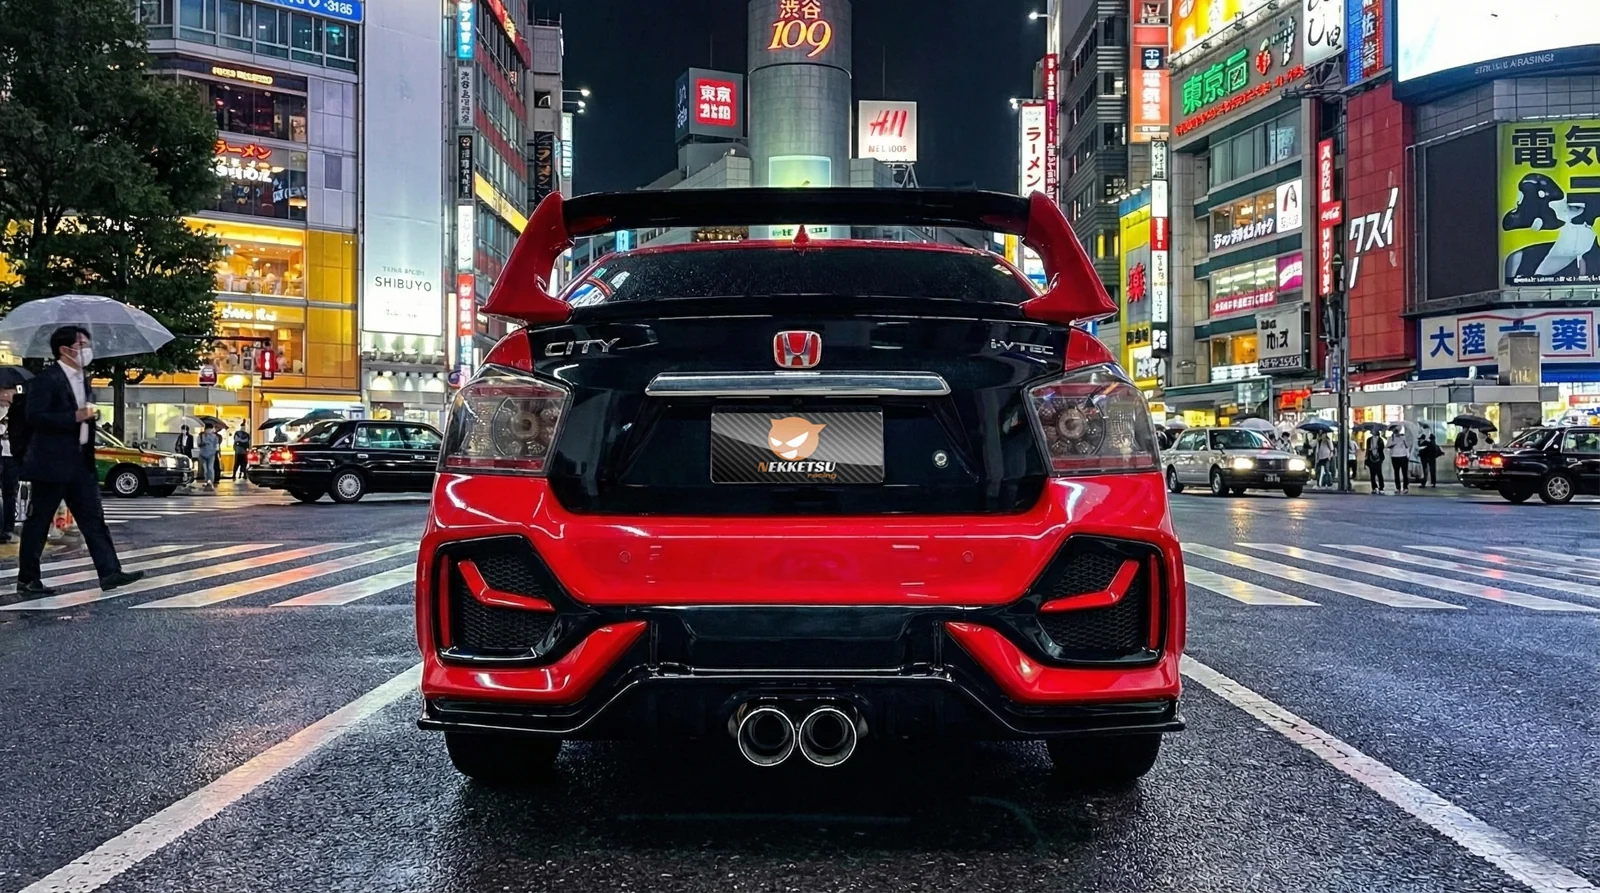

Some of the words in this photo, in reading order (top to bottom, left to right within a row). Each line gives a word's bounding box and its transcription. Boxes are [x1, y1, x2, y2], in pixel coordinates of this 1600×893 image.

[780, 0, 821, 19] 渋谷
[767, 20, 832, 57] 109
[214, 139, 272, 160] ラーメン
[1026, 126, 1042, 188] ラーメン
[375, 276, 432, 292] SHIBUYO
[544, 337, 621, 357] CITY
[757, 461, 837, 473] NEKKETSU
